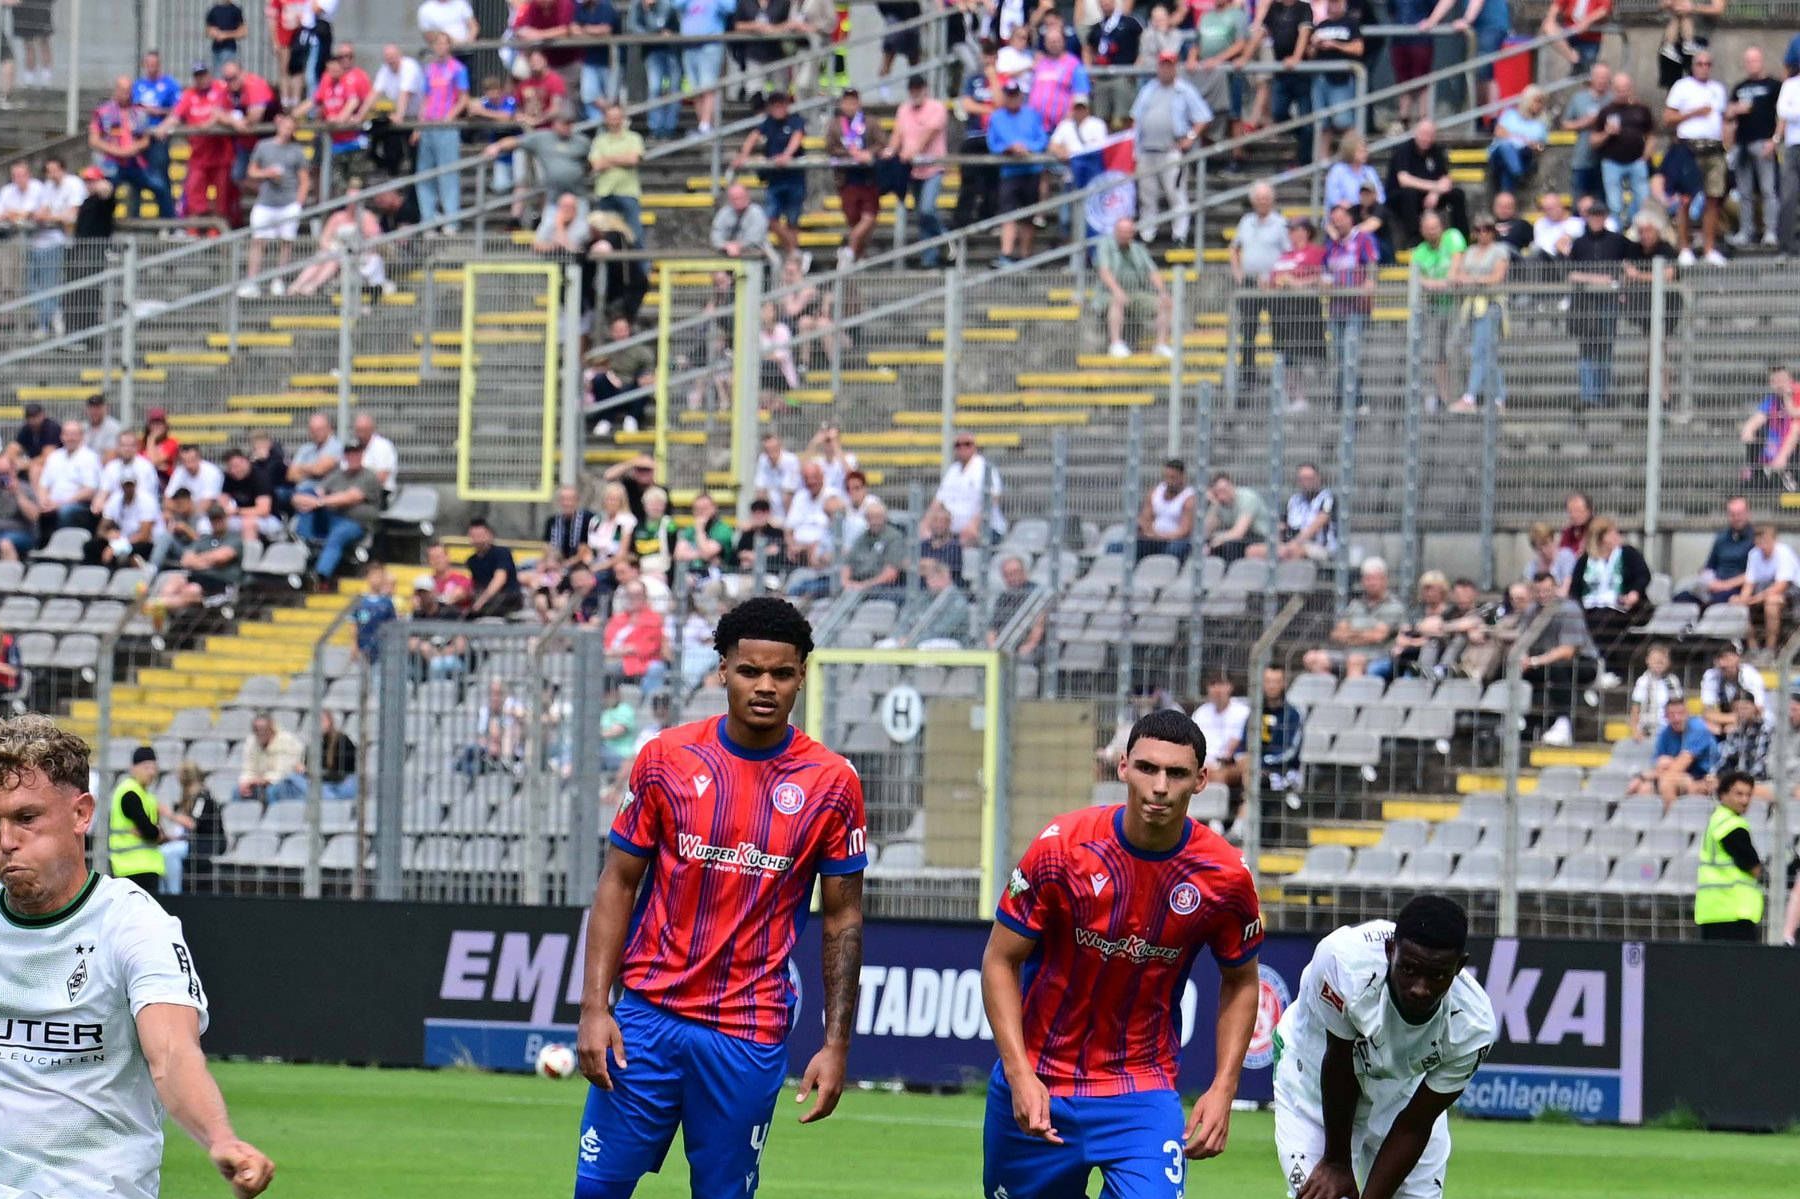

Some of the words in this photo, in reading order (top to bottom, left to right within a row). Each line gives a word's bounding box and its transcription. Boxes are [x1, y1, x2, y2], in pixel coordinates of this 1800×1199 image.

[892, 695, 913, 729] H
[440, 907, 614, 1026] EM
[1468, 938, 1607, 1047] KA
[822, 965, 996, 1041] TADIO
[1462, 1077, 1603, 1115] schlagteile
[751, 1122, 769, 1165] 4
